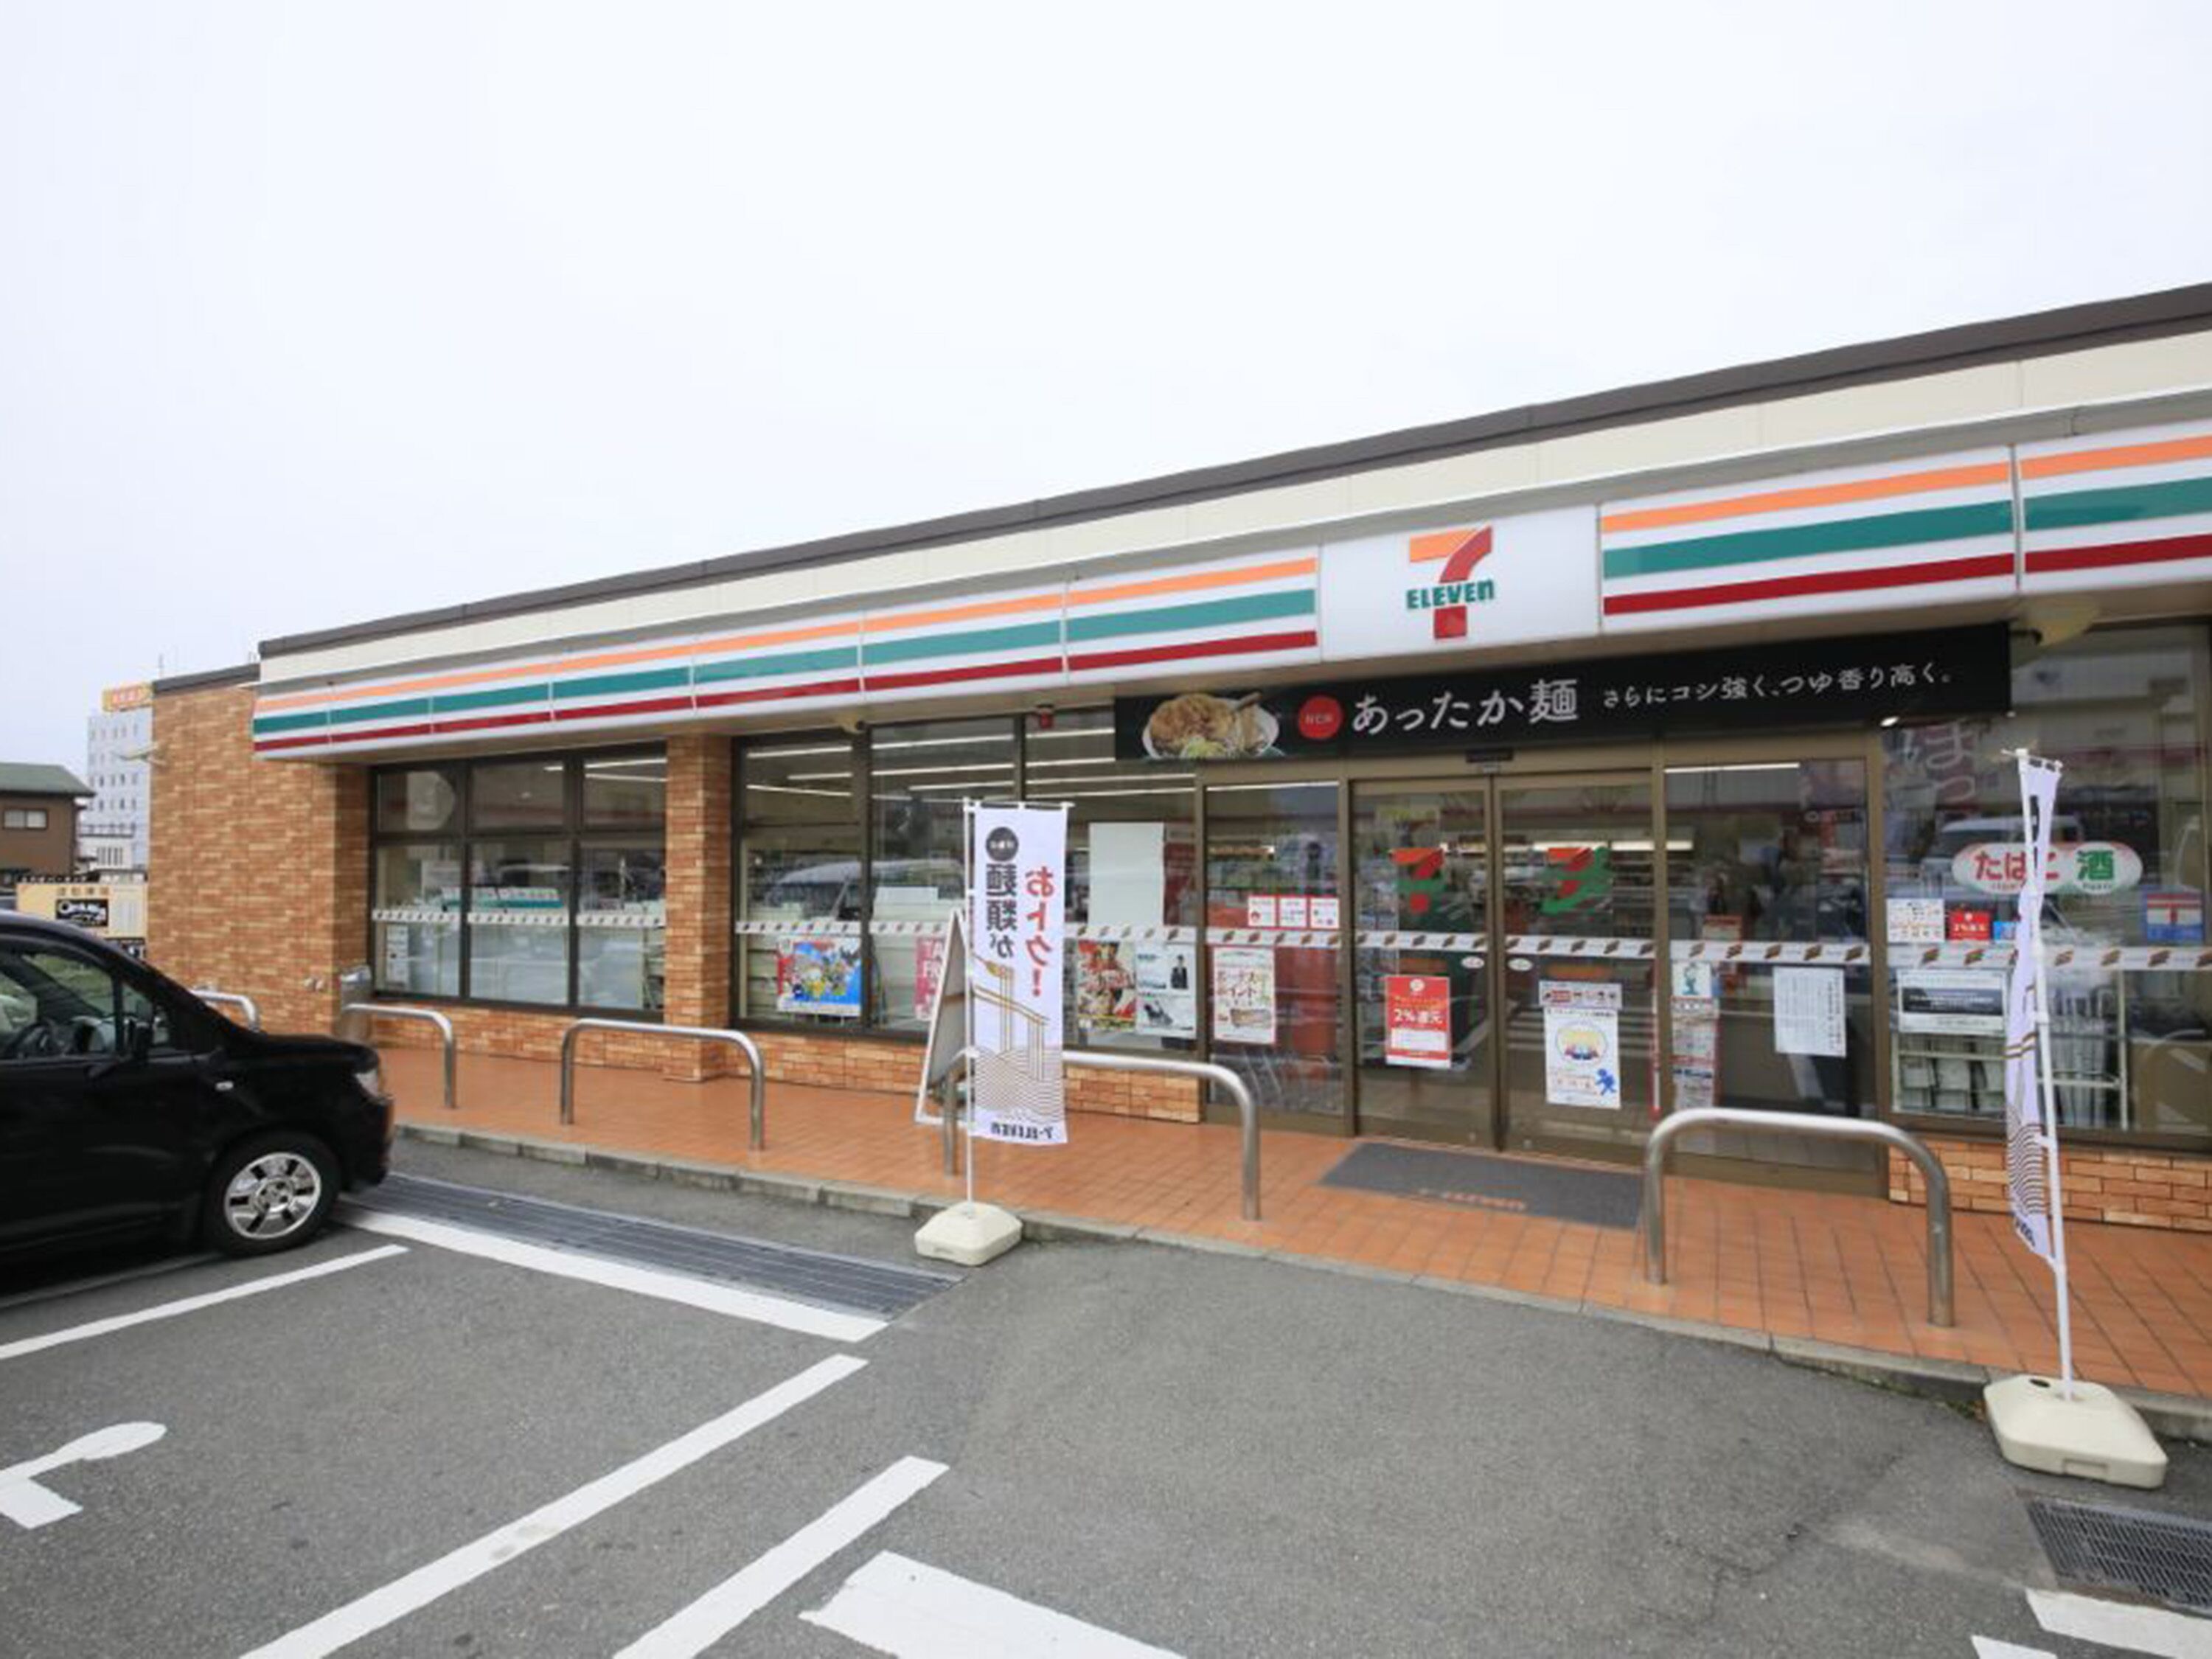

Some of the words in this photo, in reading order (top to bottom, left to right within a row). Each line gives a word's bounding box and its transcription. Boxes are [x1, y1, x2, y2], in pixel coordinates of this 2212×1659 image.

[1409, 526, 1492, 639] 7
[1352, 678, 1579, 735] あったか麺
[2076, 849, 2115, 881] 酒
